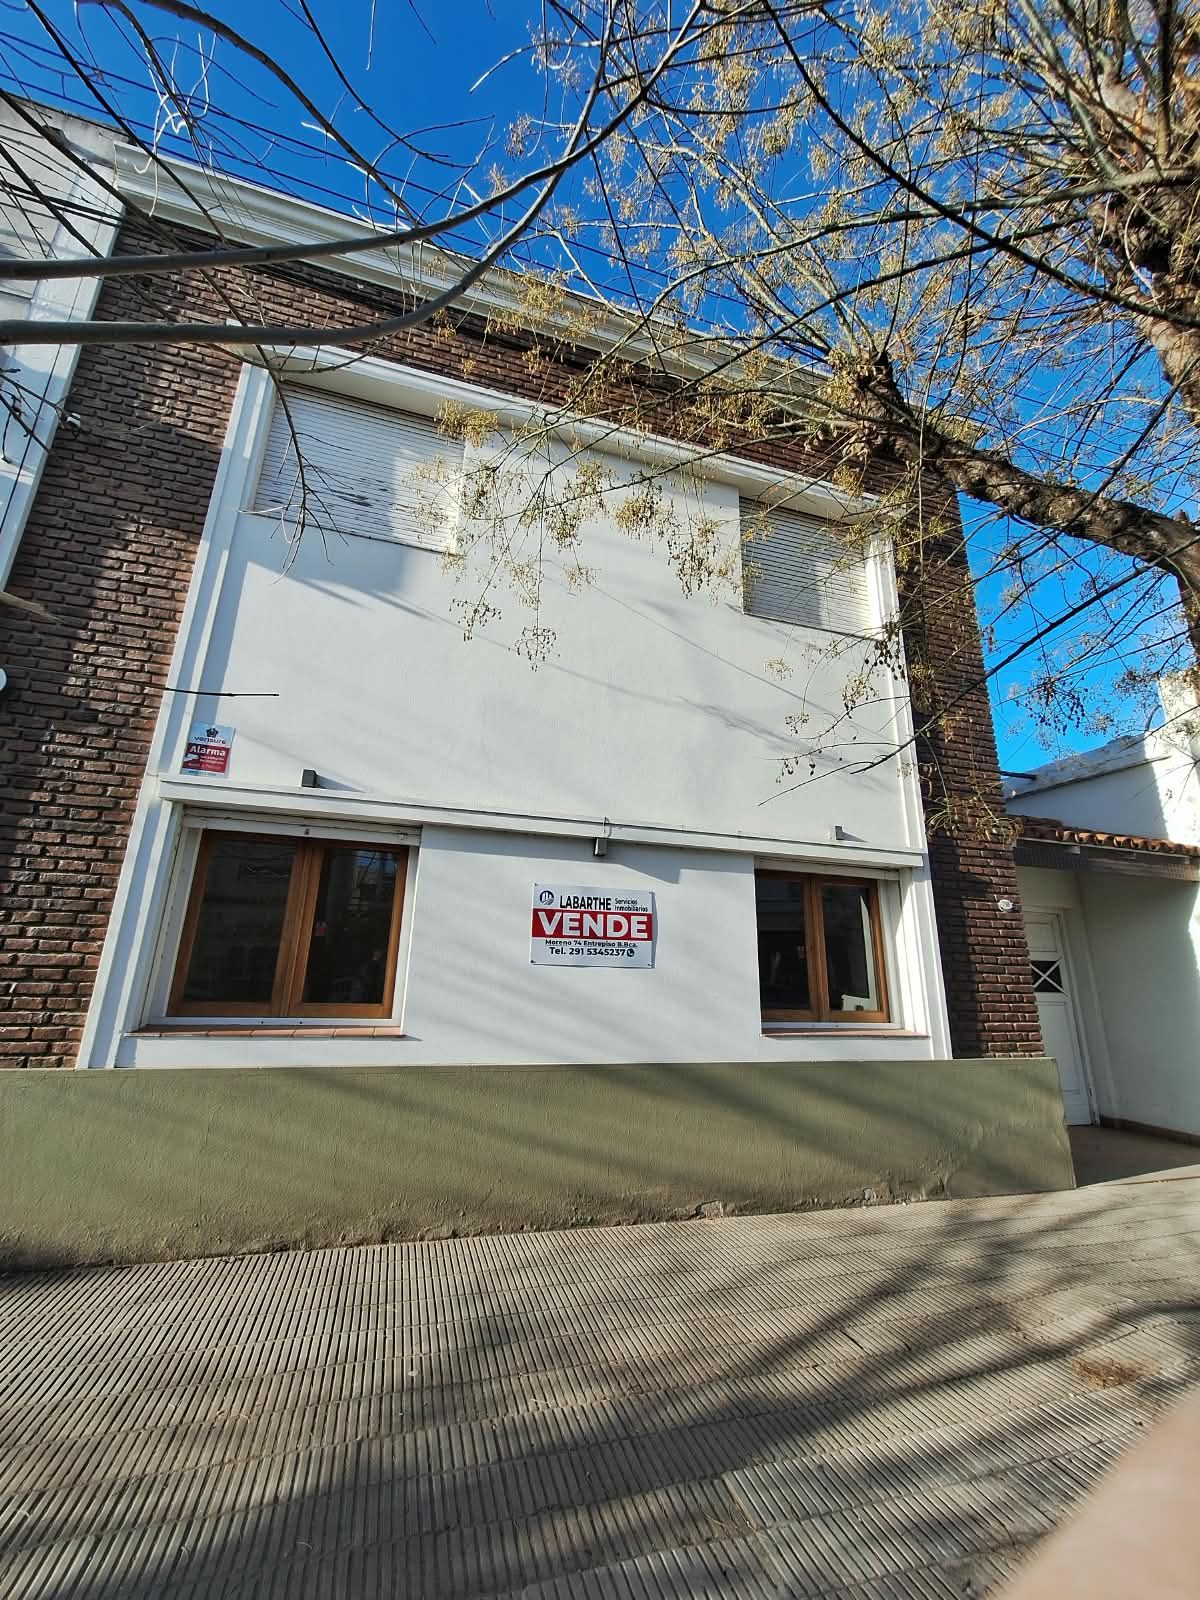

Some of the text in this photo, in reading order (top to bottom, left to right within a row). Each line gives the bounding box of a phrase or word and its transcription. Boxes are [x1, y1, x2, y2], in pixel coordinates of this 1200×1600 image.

[194, 736, 227, 744] verisure
[190, 745, 226, 756] Alarma
[560, 895, 612, 911] LABARTHE
[537, 911, 649, 939] VENDE
[584, 940, 615, 948] Entrepiso
[549, 947, 626, 957] Tel. 291 5345237
